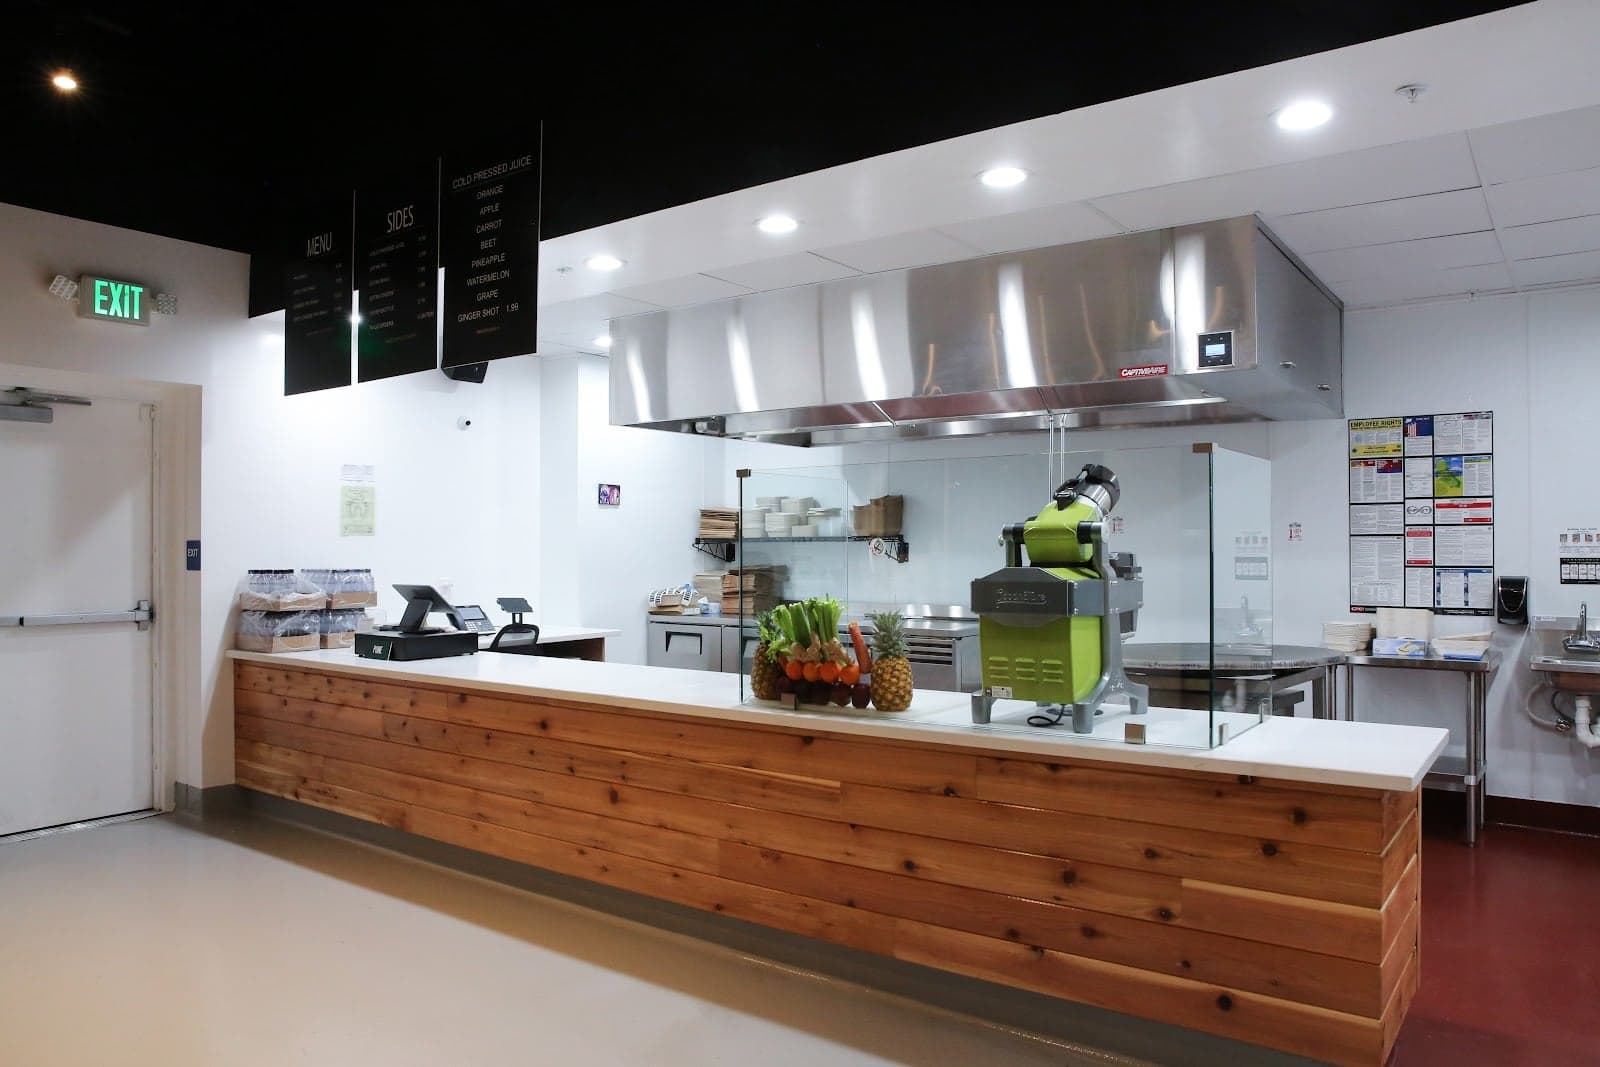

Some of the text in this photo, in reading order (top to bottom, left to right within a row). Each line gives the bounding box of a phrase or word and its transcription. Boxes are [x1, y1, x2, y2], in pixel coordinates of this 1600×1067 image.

[452, 155, 532, 189] COLD PRESSED JUICE
[476, 185, 504, 199] ORANGE
[480, 203, 500, 215] APPLE
[387, 205, 414, 232] SIDES
[476, 219, 503, 233] CARROT
[307, 232, 333, 256] MENU
[480, 238, 497, 250] BEET
[471, 253, 506, 268] PINEAPPLE
[467, 270, 510, 286] WATERMELON
[95, 280, 143, 320] EXIT
[476, 289, 499, 301] GRAPE
[457, 311, 481, 322] GINGER
[482, 307, 500, 317] SHOT
[187, 548, 198, 557] EXIT
